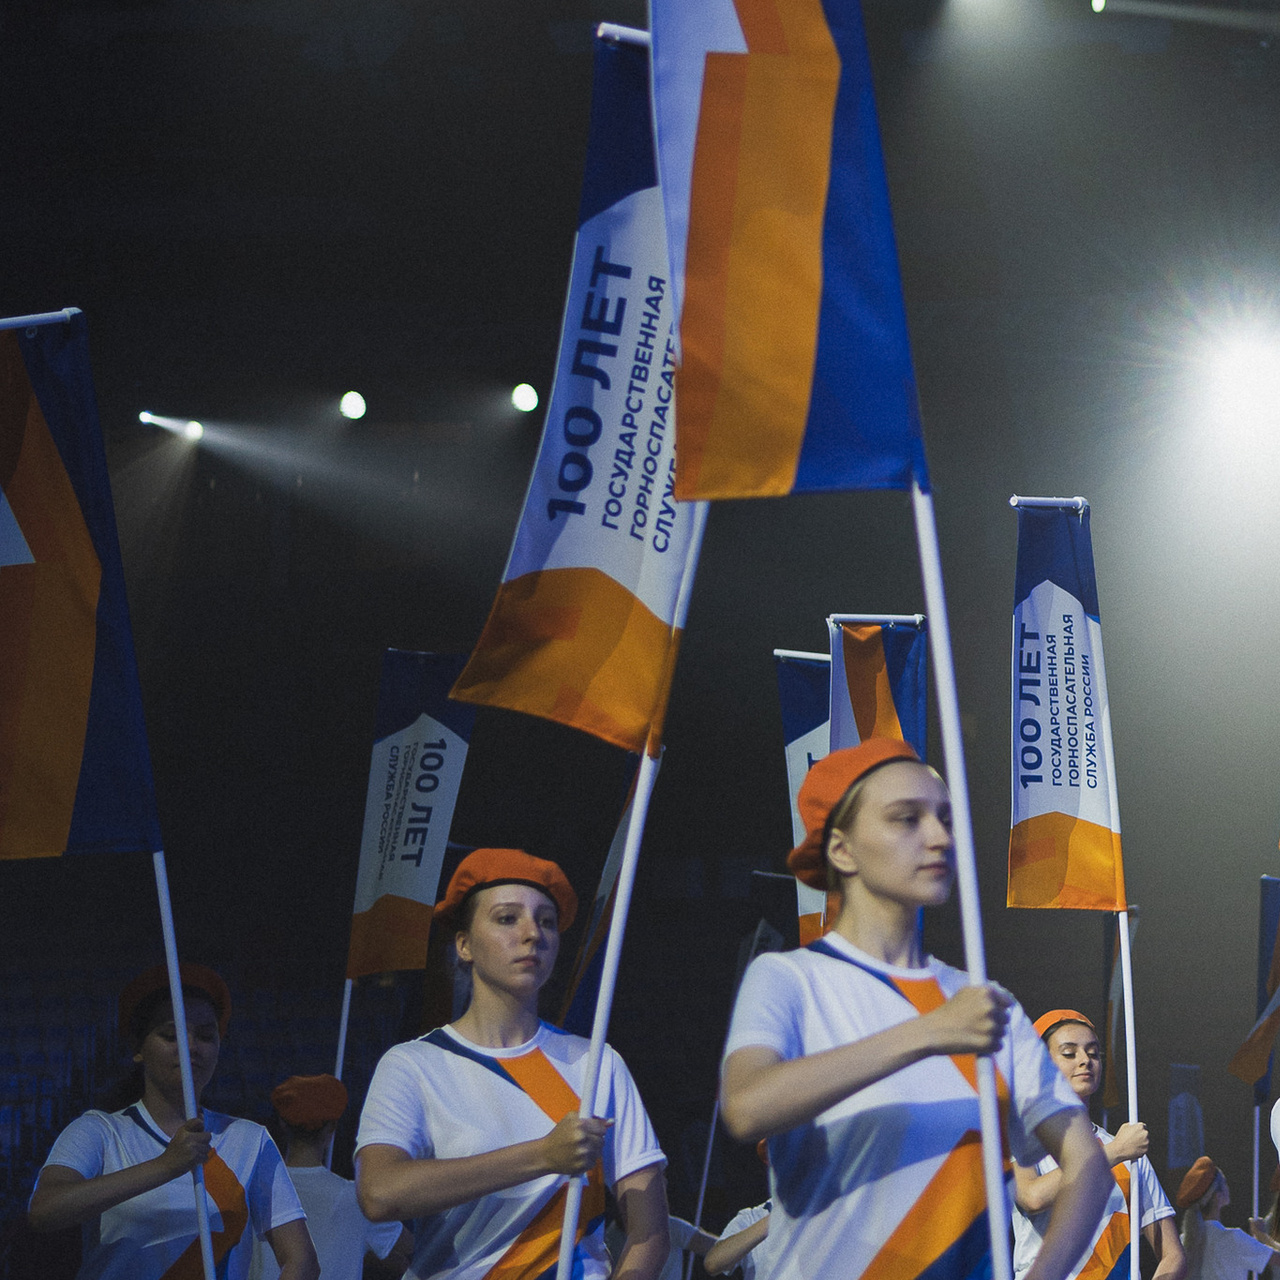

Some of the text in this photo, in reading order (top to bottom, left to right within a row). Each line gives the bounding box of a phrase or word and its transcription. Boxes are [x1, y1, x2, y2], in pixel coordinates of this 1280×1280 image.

[548, 247, 632, 521] 100 ЛЕТ
[602, 276, 665, 530] ГОСУДАРСТВЕННАЯ
[630, 321, 676, 541] ГОРНОСПАСАТ
[653, 442, 677, 553] СЛУЖ
[1018, 622, 1043, 789] 100 ЛЕТ
[1046, 635, 1062, 786] ГОСУДАРСТВЕННАЯ
[1063, 615, 1079, 787] ГОРНОСПАСАТЕЛЬНАЯ
[1082, 655, 1097, 788] СЛУЖБА РОССИИ
[378, 746, 399, 853] СЛУЖБА РОССИИ
[401, 738, 447, 867] 100 ЛЕТ
